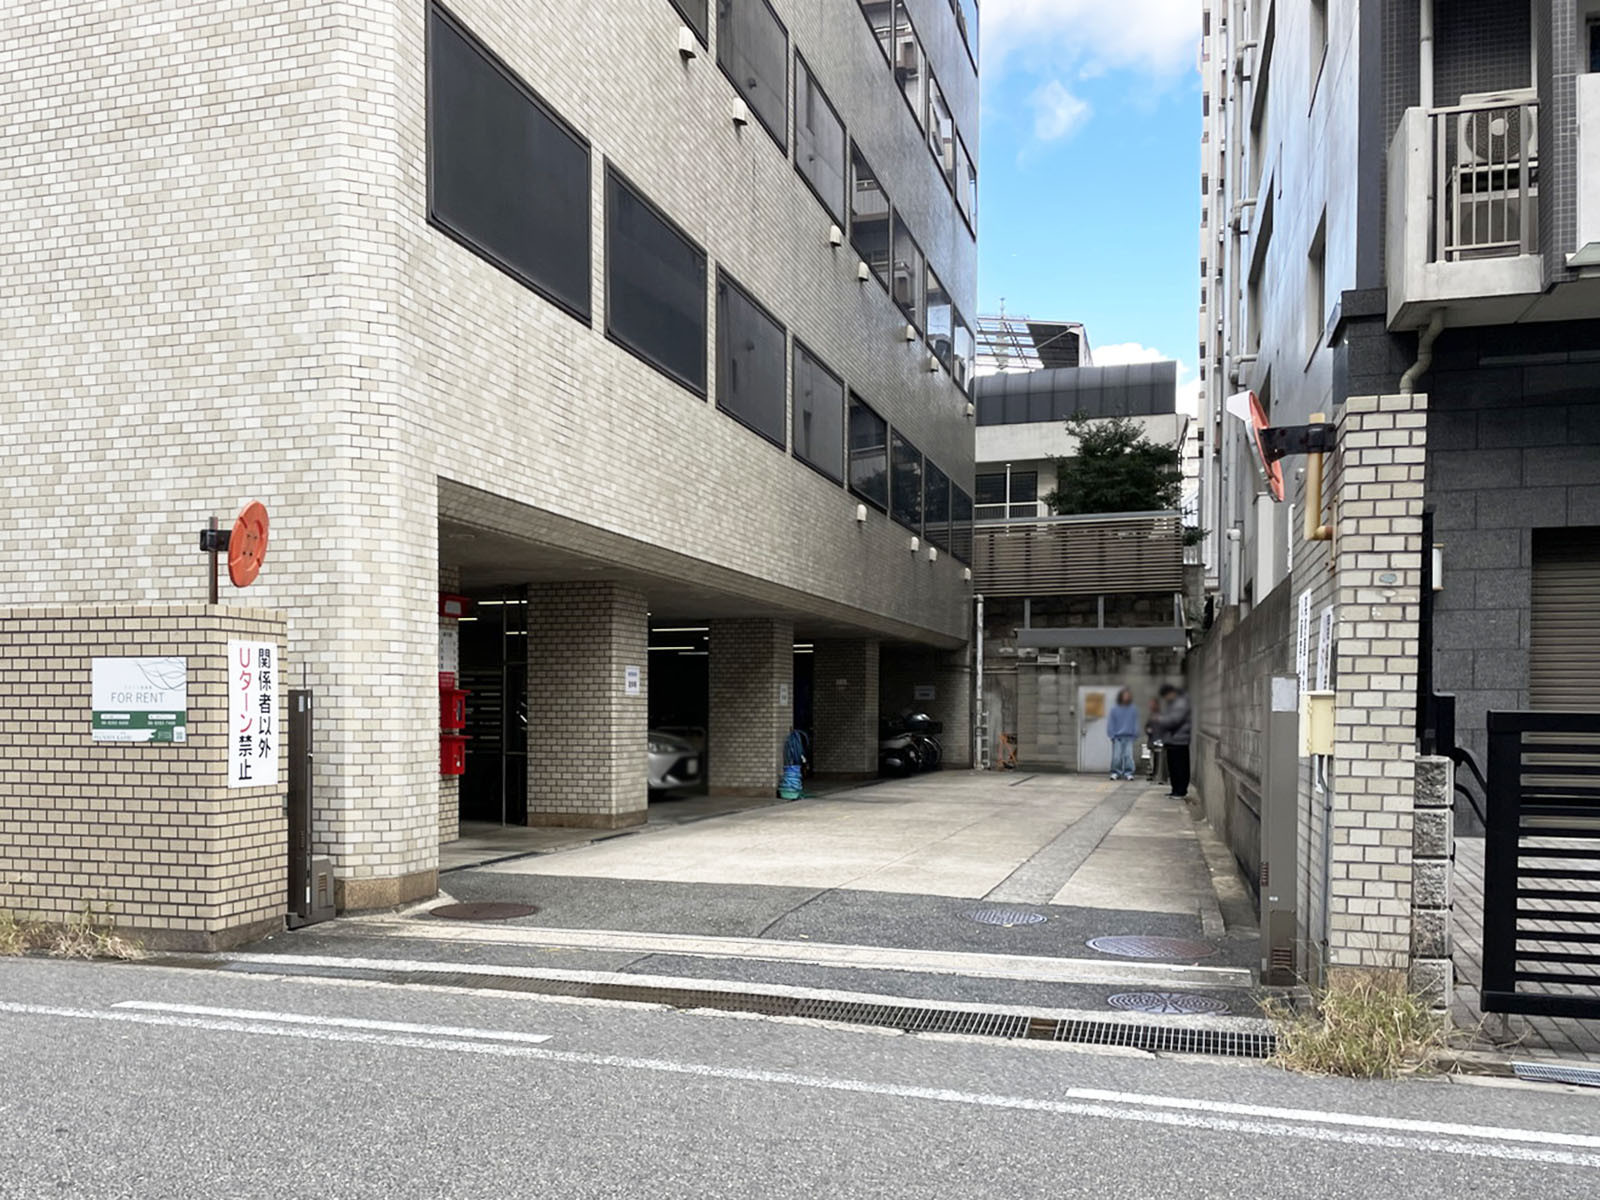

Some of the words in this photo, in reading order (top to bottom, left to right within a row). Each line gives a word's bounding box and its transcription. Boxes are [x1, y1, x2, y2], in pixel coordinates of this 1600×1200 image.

[111, 692, 133, 704] FOR
[135, 692, 165, 704] RENT
[239, 648, 252, 780] Uターン禁止
[258, 648, 271, 759] 関係者以外
